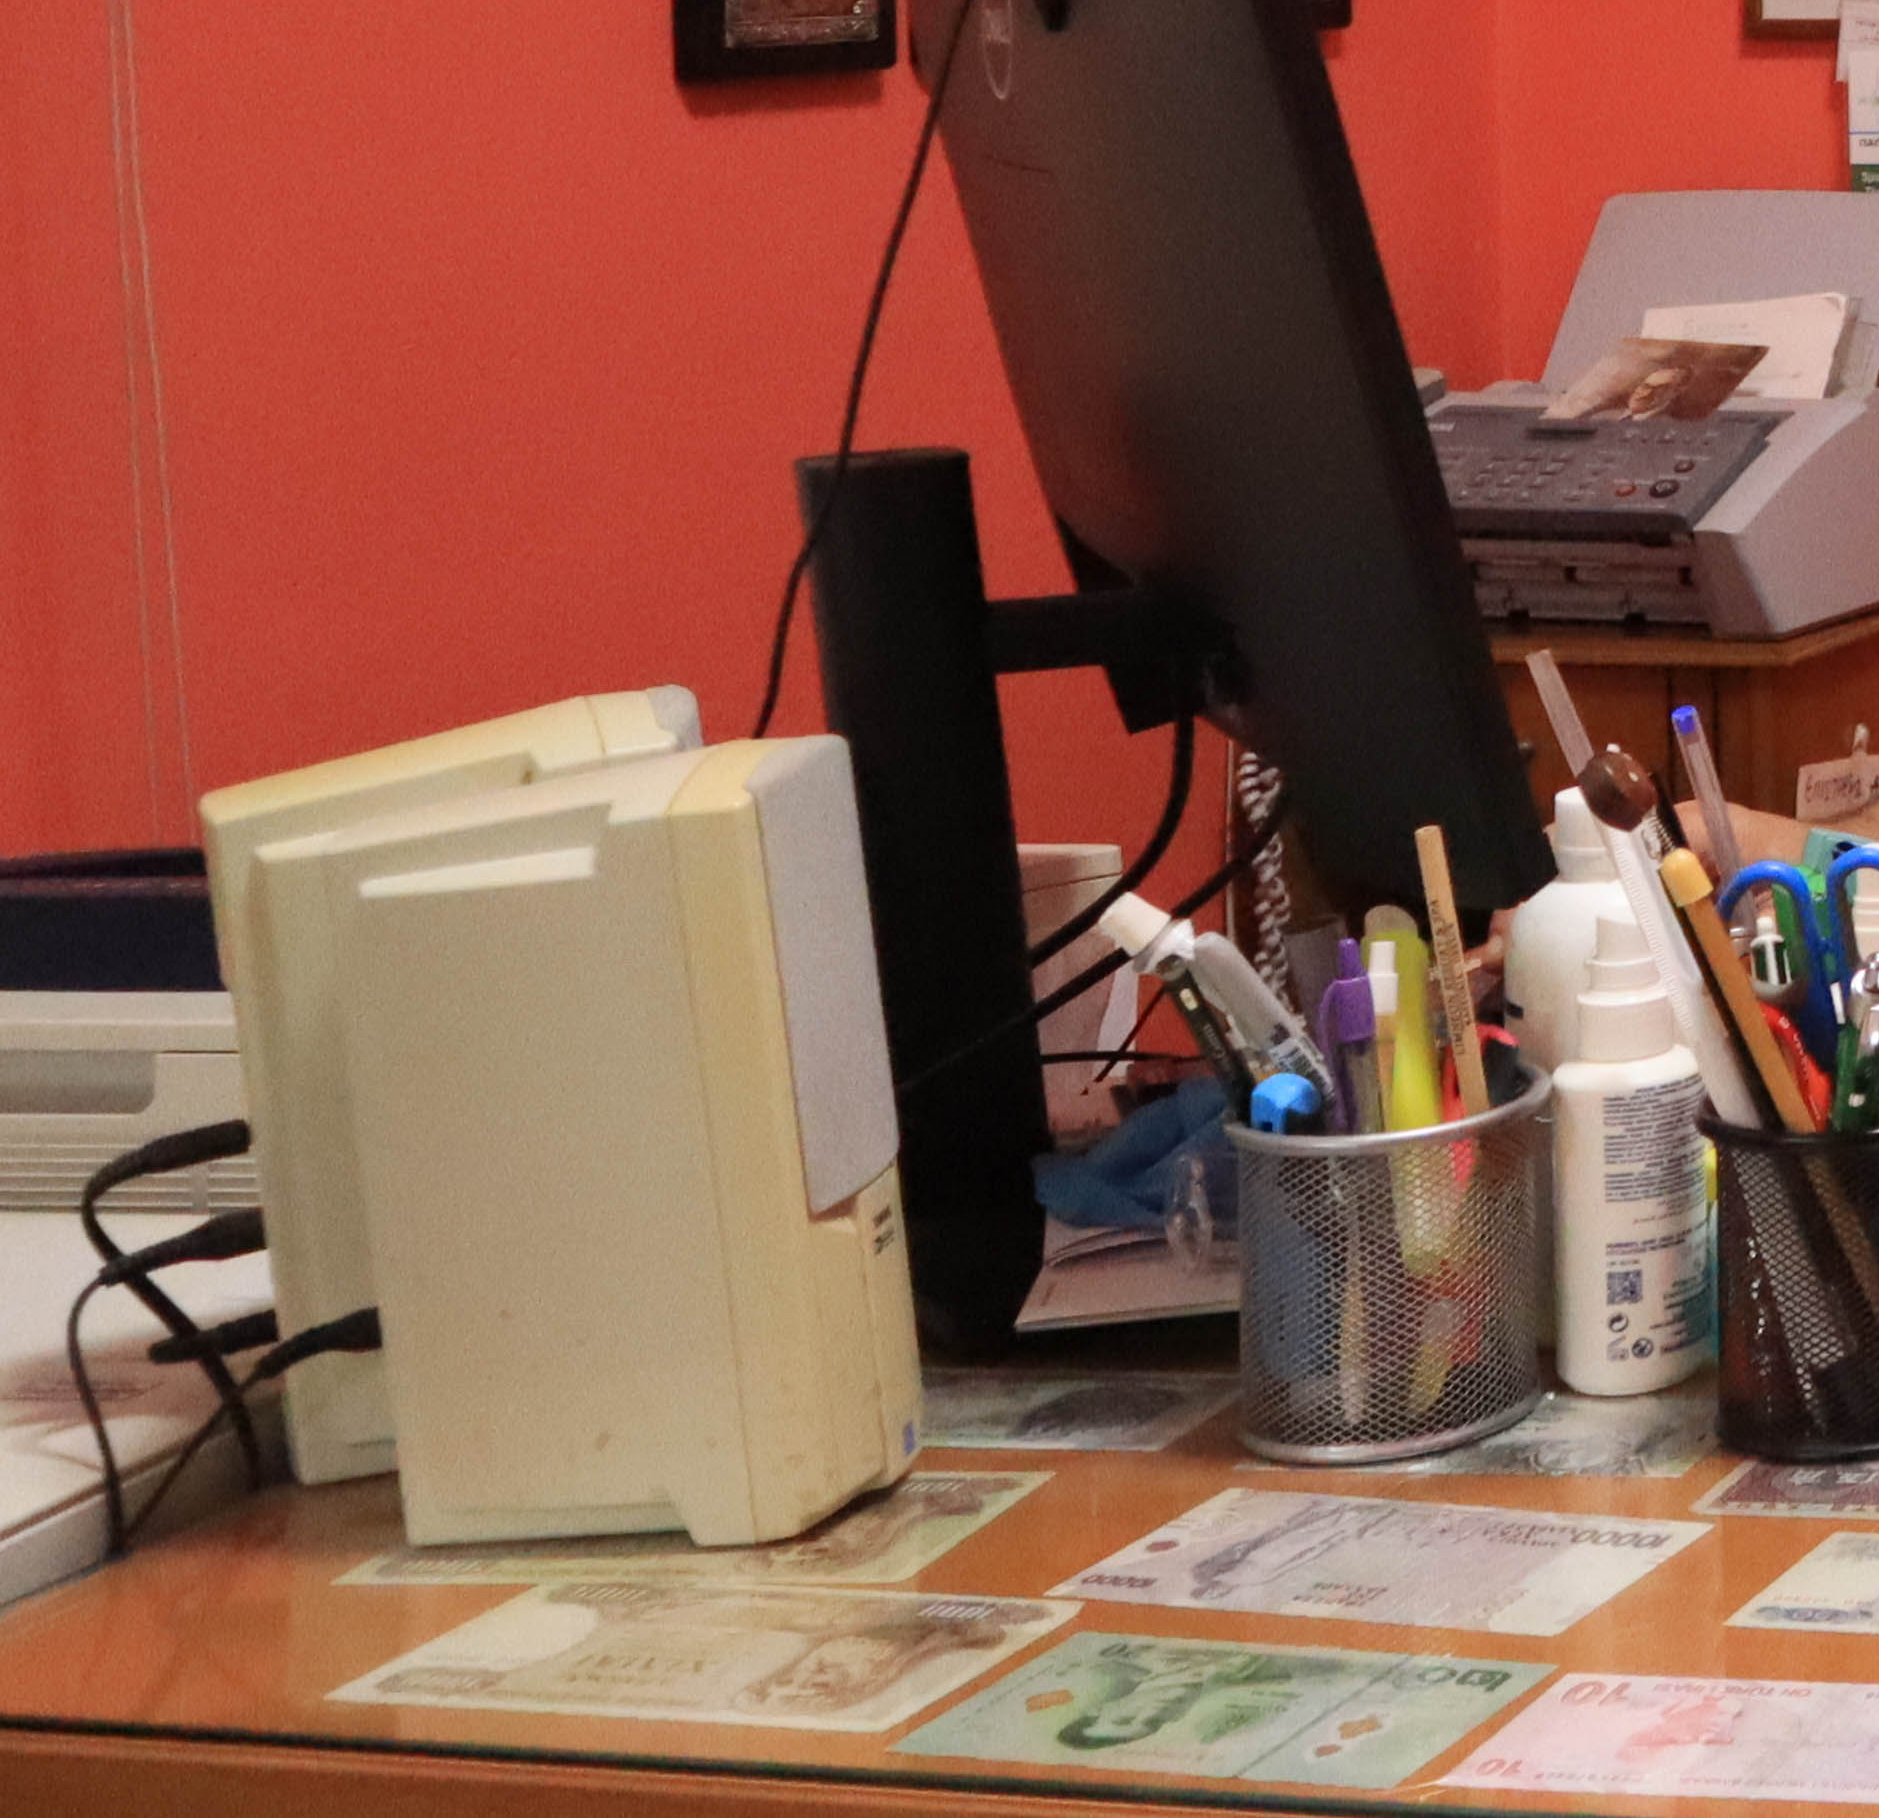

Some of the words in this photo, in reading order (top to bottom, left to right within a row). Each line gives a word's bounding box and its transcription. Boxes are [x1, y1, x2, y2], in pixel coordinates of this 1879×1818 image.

[1569, 1528, 1672, 1553] 10000
[1561, 1682, 1630, 1707] 10
[1475, 1756, 1525, 1778] 10
